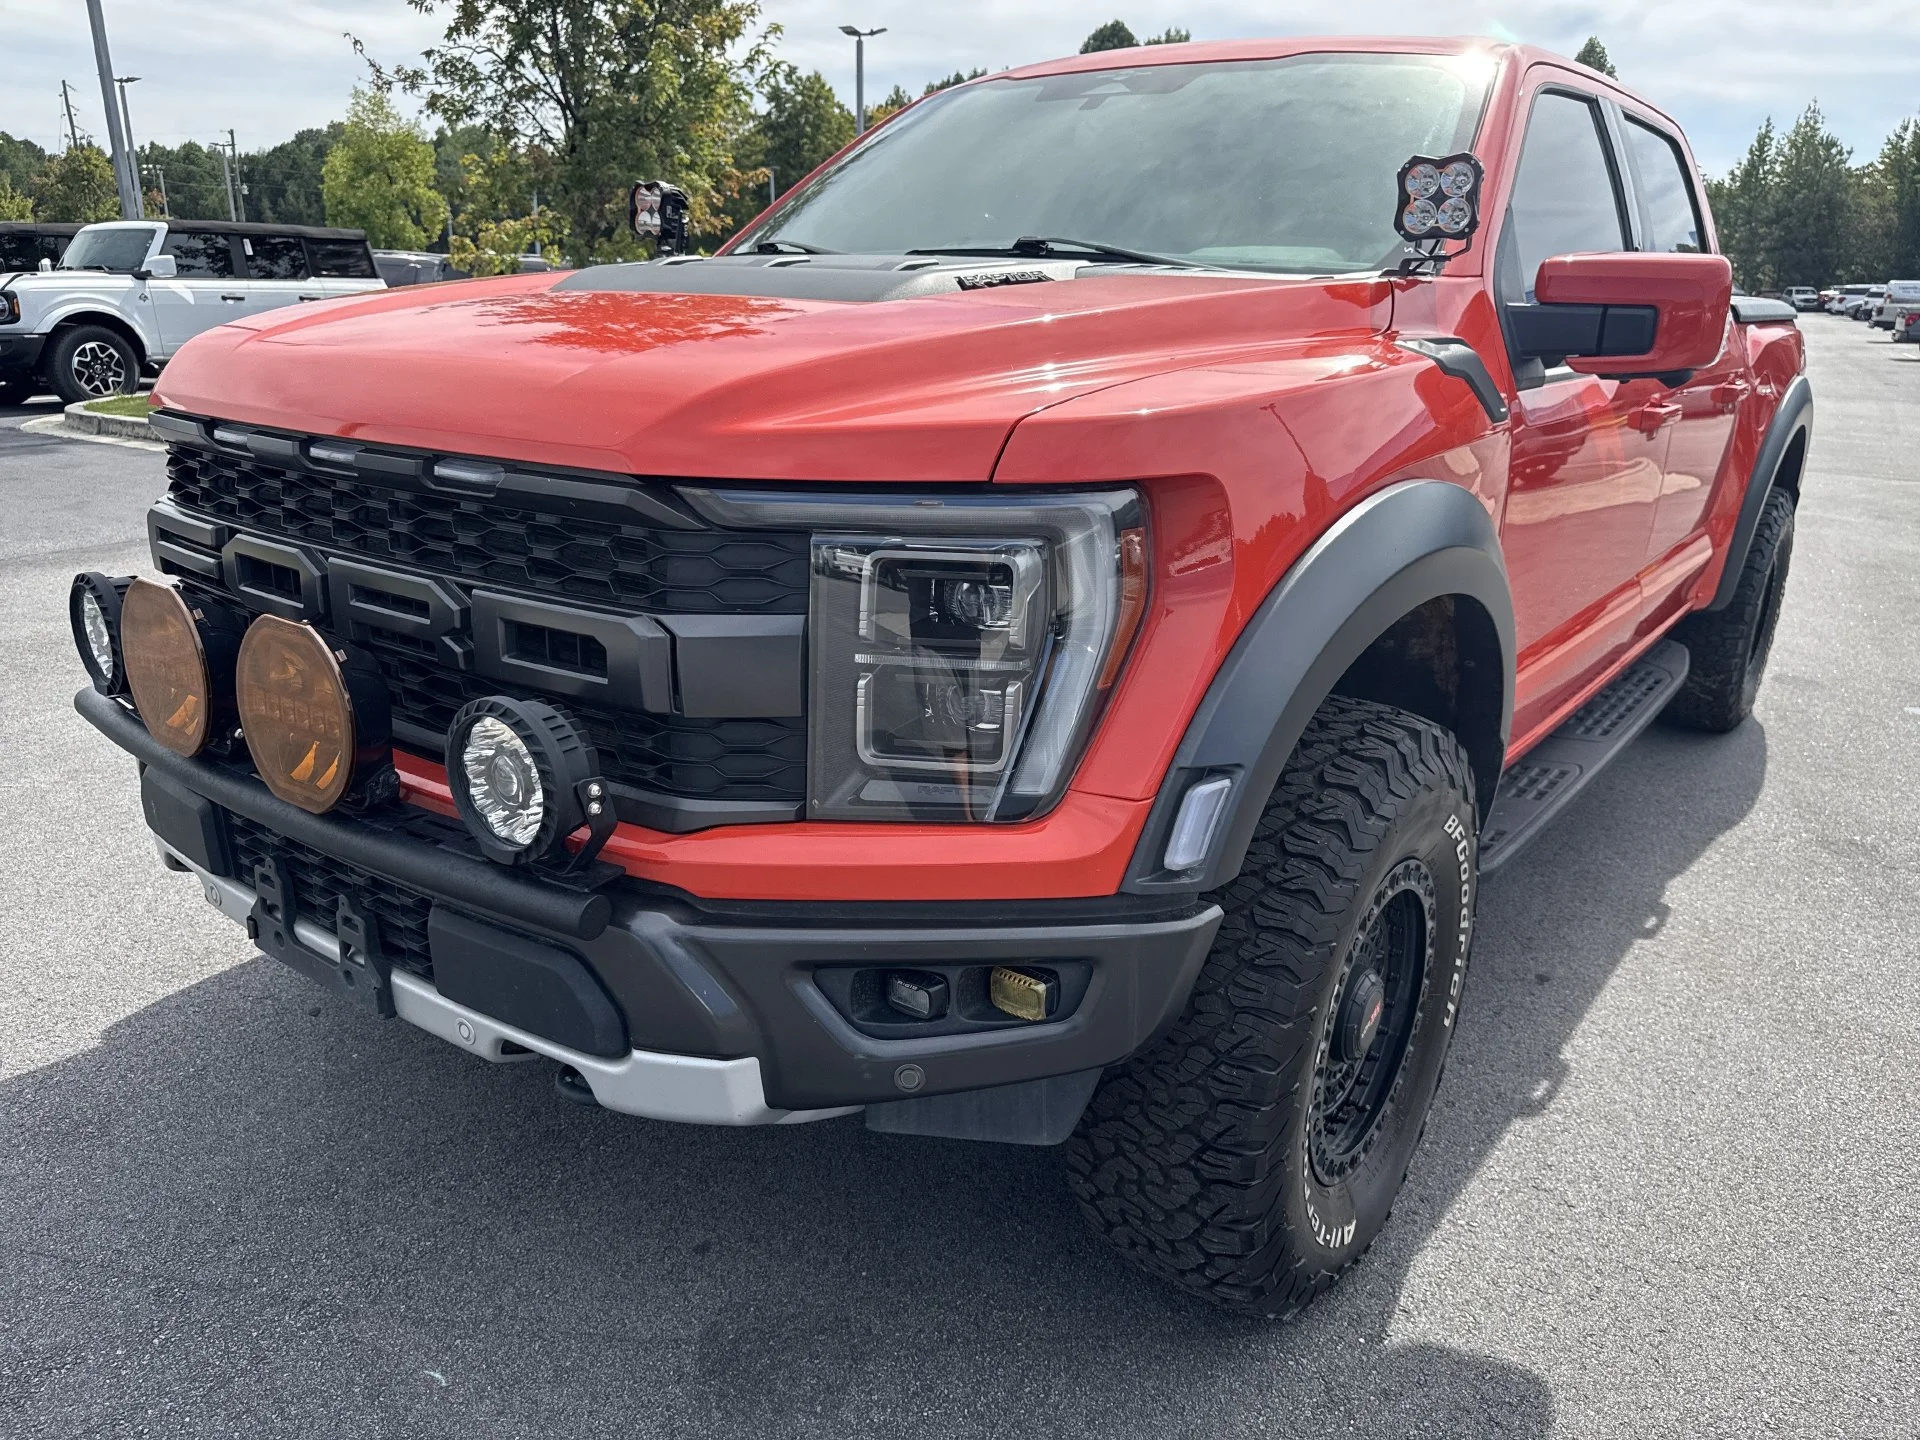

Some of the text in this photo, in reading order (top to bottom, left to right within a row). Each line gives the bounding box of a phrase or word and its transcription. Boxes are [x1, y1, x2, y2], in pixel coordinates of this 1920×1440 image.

[954, 270, 1055, 291] RAPTOR
[147, 499, 673, 714] FORD
[1443, 814, 1469, 1028] BFGoodrich
